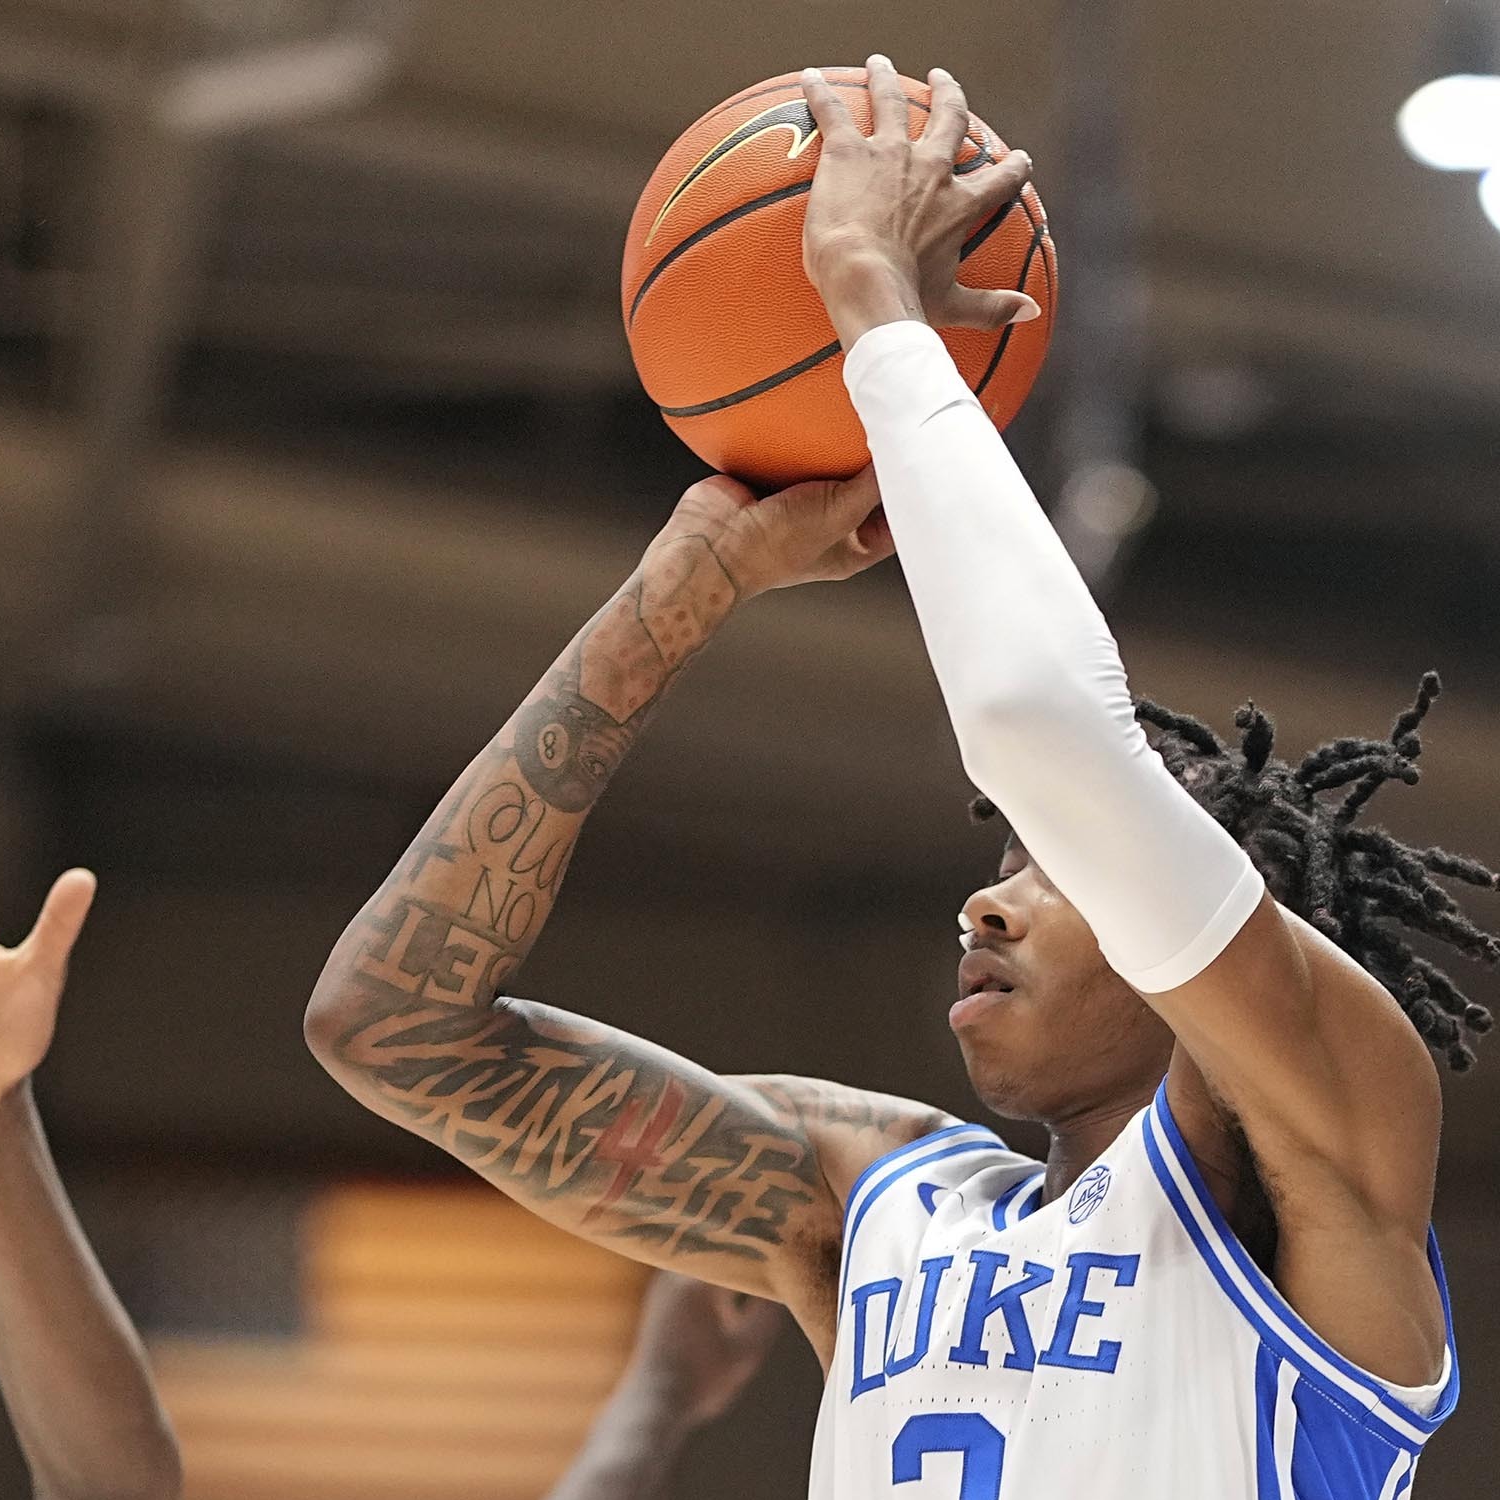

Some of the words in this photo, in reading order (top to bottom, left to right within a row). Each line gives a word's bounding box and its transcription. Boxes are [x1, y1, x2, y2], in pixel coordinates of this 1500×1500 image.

[460, 864, 536, 944] ON
[579, 1072, 686, 1225] 4
[1074, 1173, 1109, 1208] ACC
[850, 1250, 1141, 1404] DUKE
